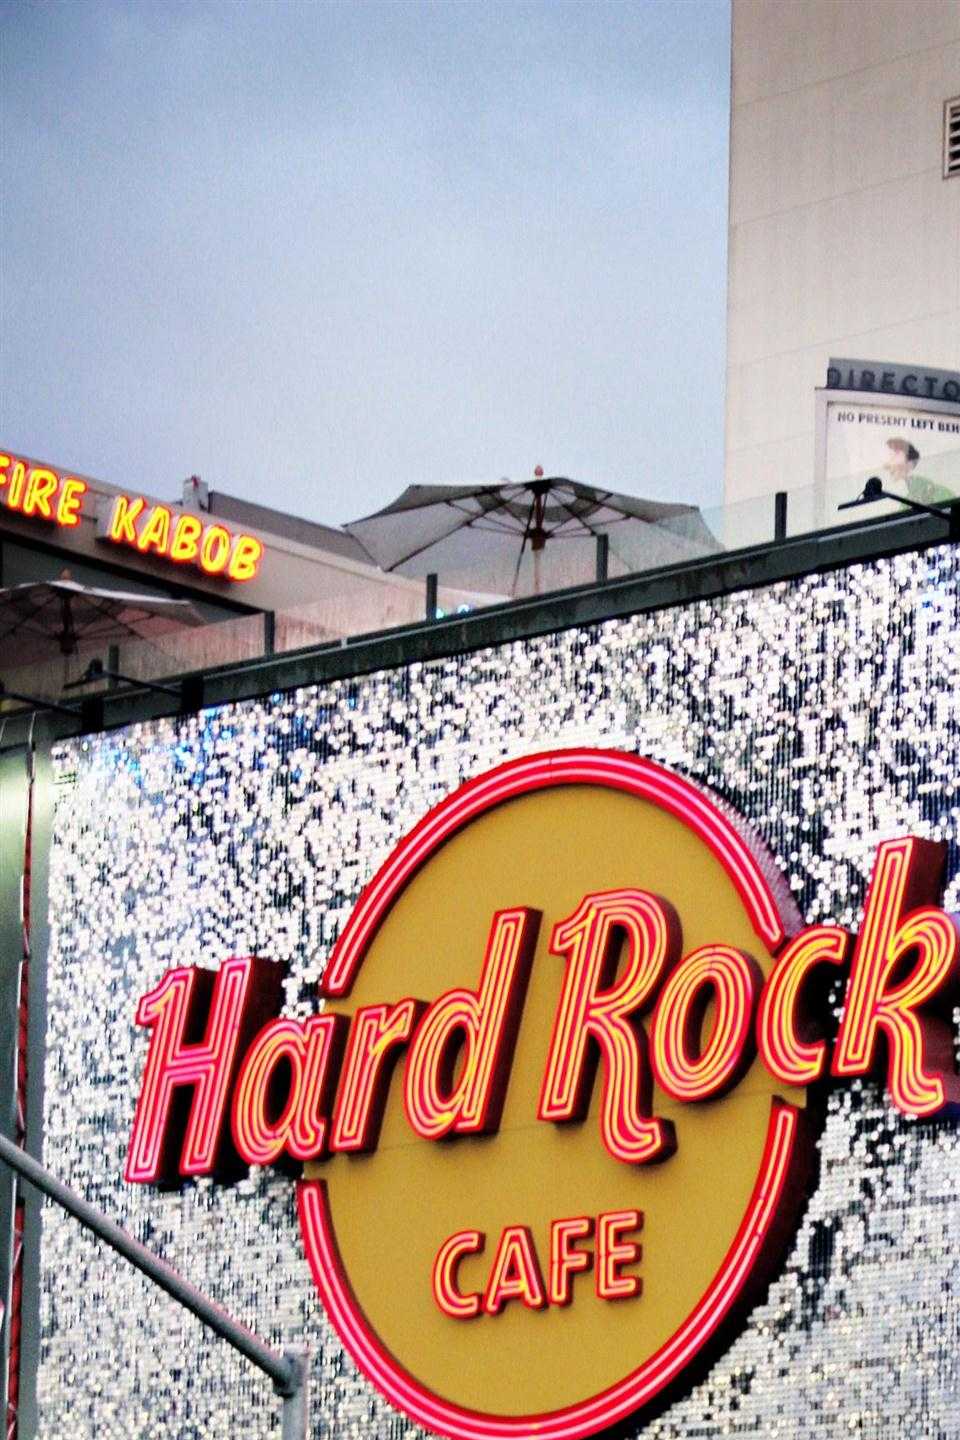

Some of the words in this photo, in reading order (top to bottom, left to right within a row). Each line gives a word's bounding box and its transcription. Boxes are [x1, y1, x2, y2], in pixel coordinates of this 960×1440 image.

[837, 411, 856, 423] NO
[858, 413, 908, 429] PRESENT
[911, 418, 935, 431] LEFT
[107, 494, 266, 583] KABOB
[124, 906, 541, 1186] Hard
[432, 1210, 645, 1320] CAFE
